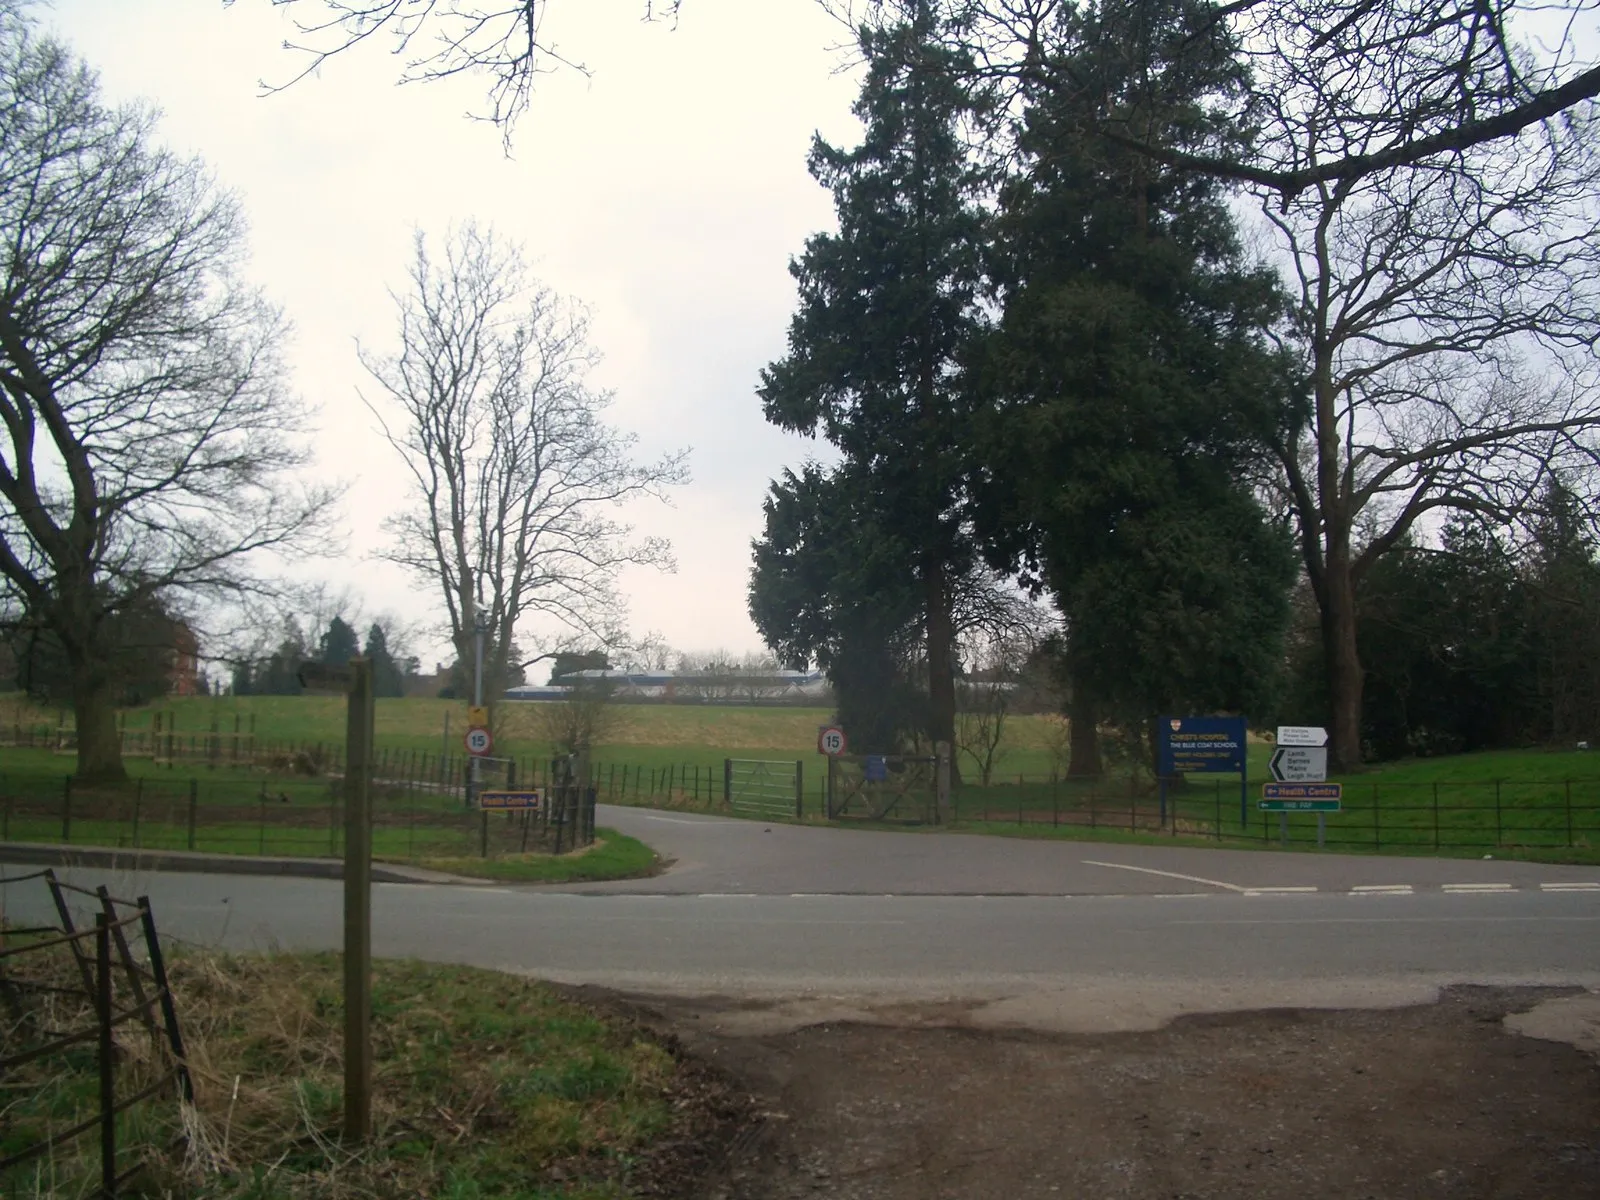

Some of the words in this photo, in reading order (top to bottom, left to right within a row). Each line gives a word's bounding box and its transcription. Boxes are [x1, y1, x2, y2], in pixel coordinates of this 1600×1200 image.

[472, 736, 485, 747] 15
[826, 736, 840, 748] 15
[1278, 787, 1306, 796] Health
[1308, 787, 1338, 796] Centre
[483, 797, 505, 806] Health
[506, 796, 528, 806] Centre
